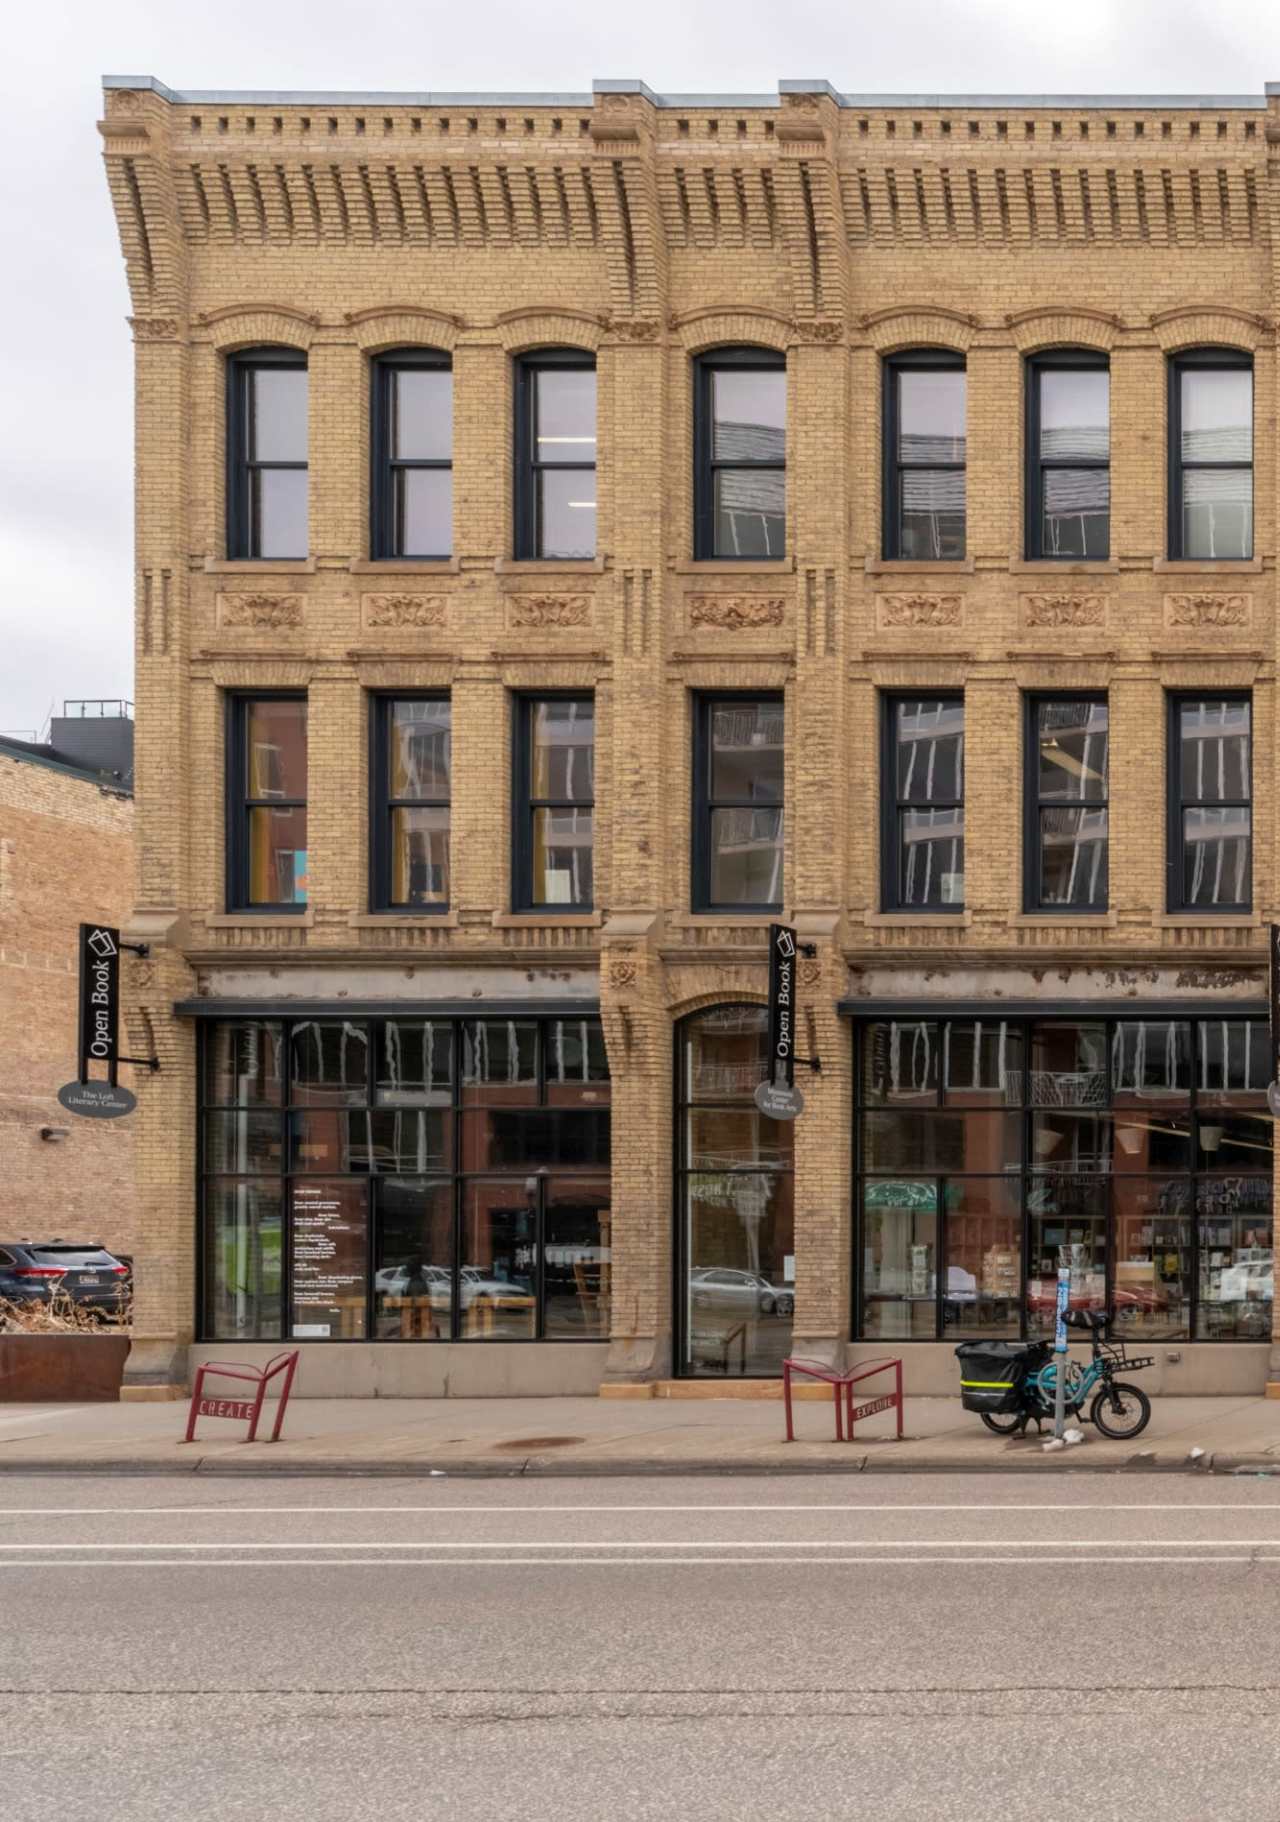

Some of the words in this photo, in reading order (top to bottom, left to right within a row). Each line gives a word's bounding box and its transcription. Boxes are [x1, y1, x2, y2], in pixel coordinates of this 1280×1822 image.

[92, 960, 110, 1006] Book
[778, 962, 791, 1006] Book
[91, 1010, 112, 1057] Open
[777, 1011, 791, 1057] Open
[68, 1096, 99, 1107] Literary
[101, 1098, 127, 1109] Center
[82, 1090, 97, 1099] The
[99, 1091, 114, 1101] Loft
[200, 1400, 254, 1419] CREATE
